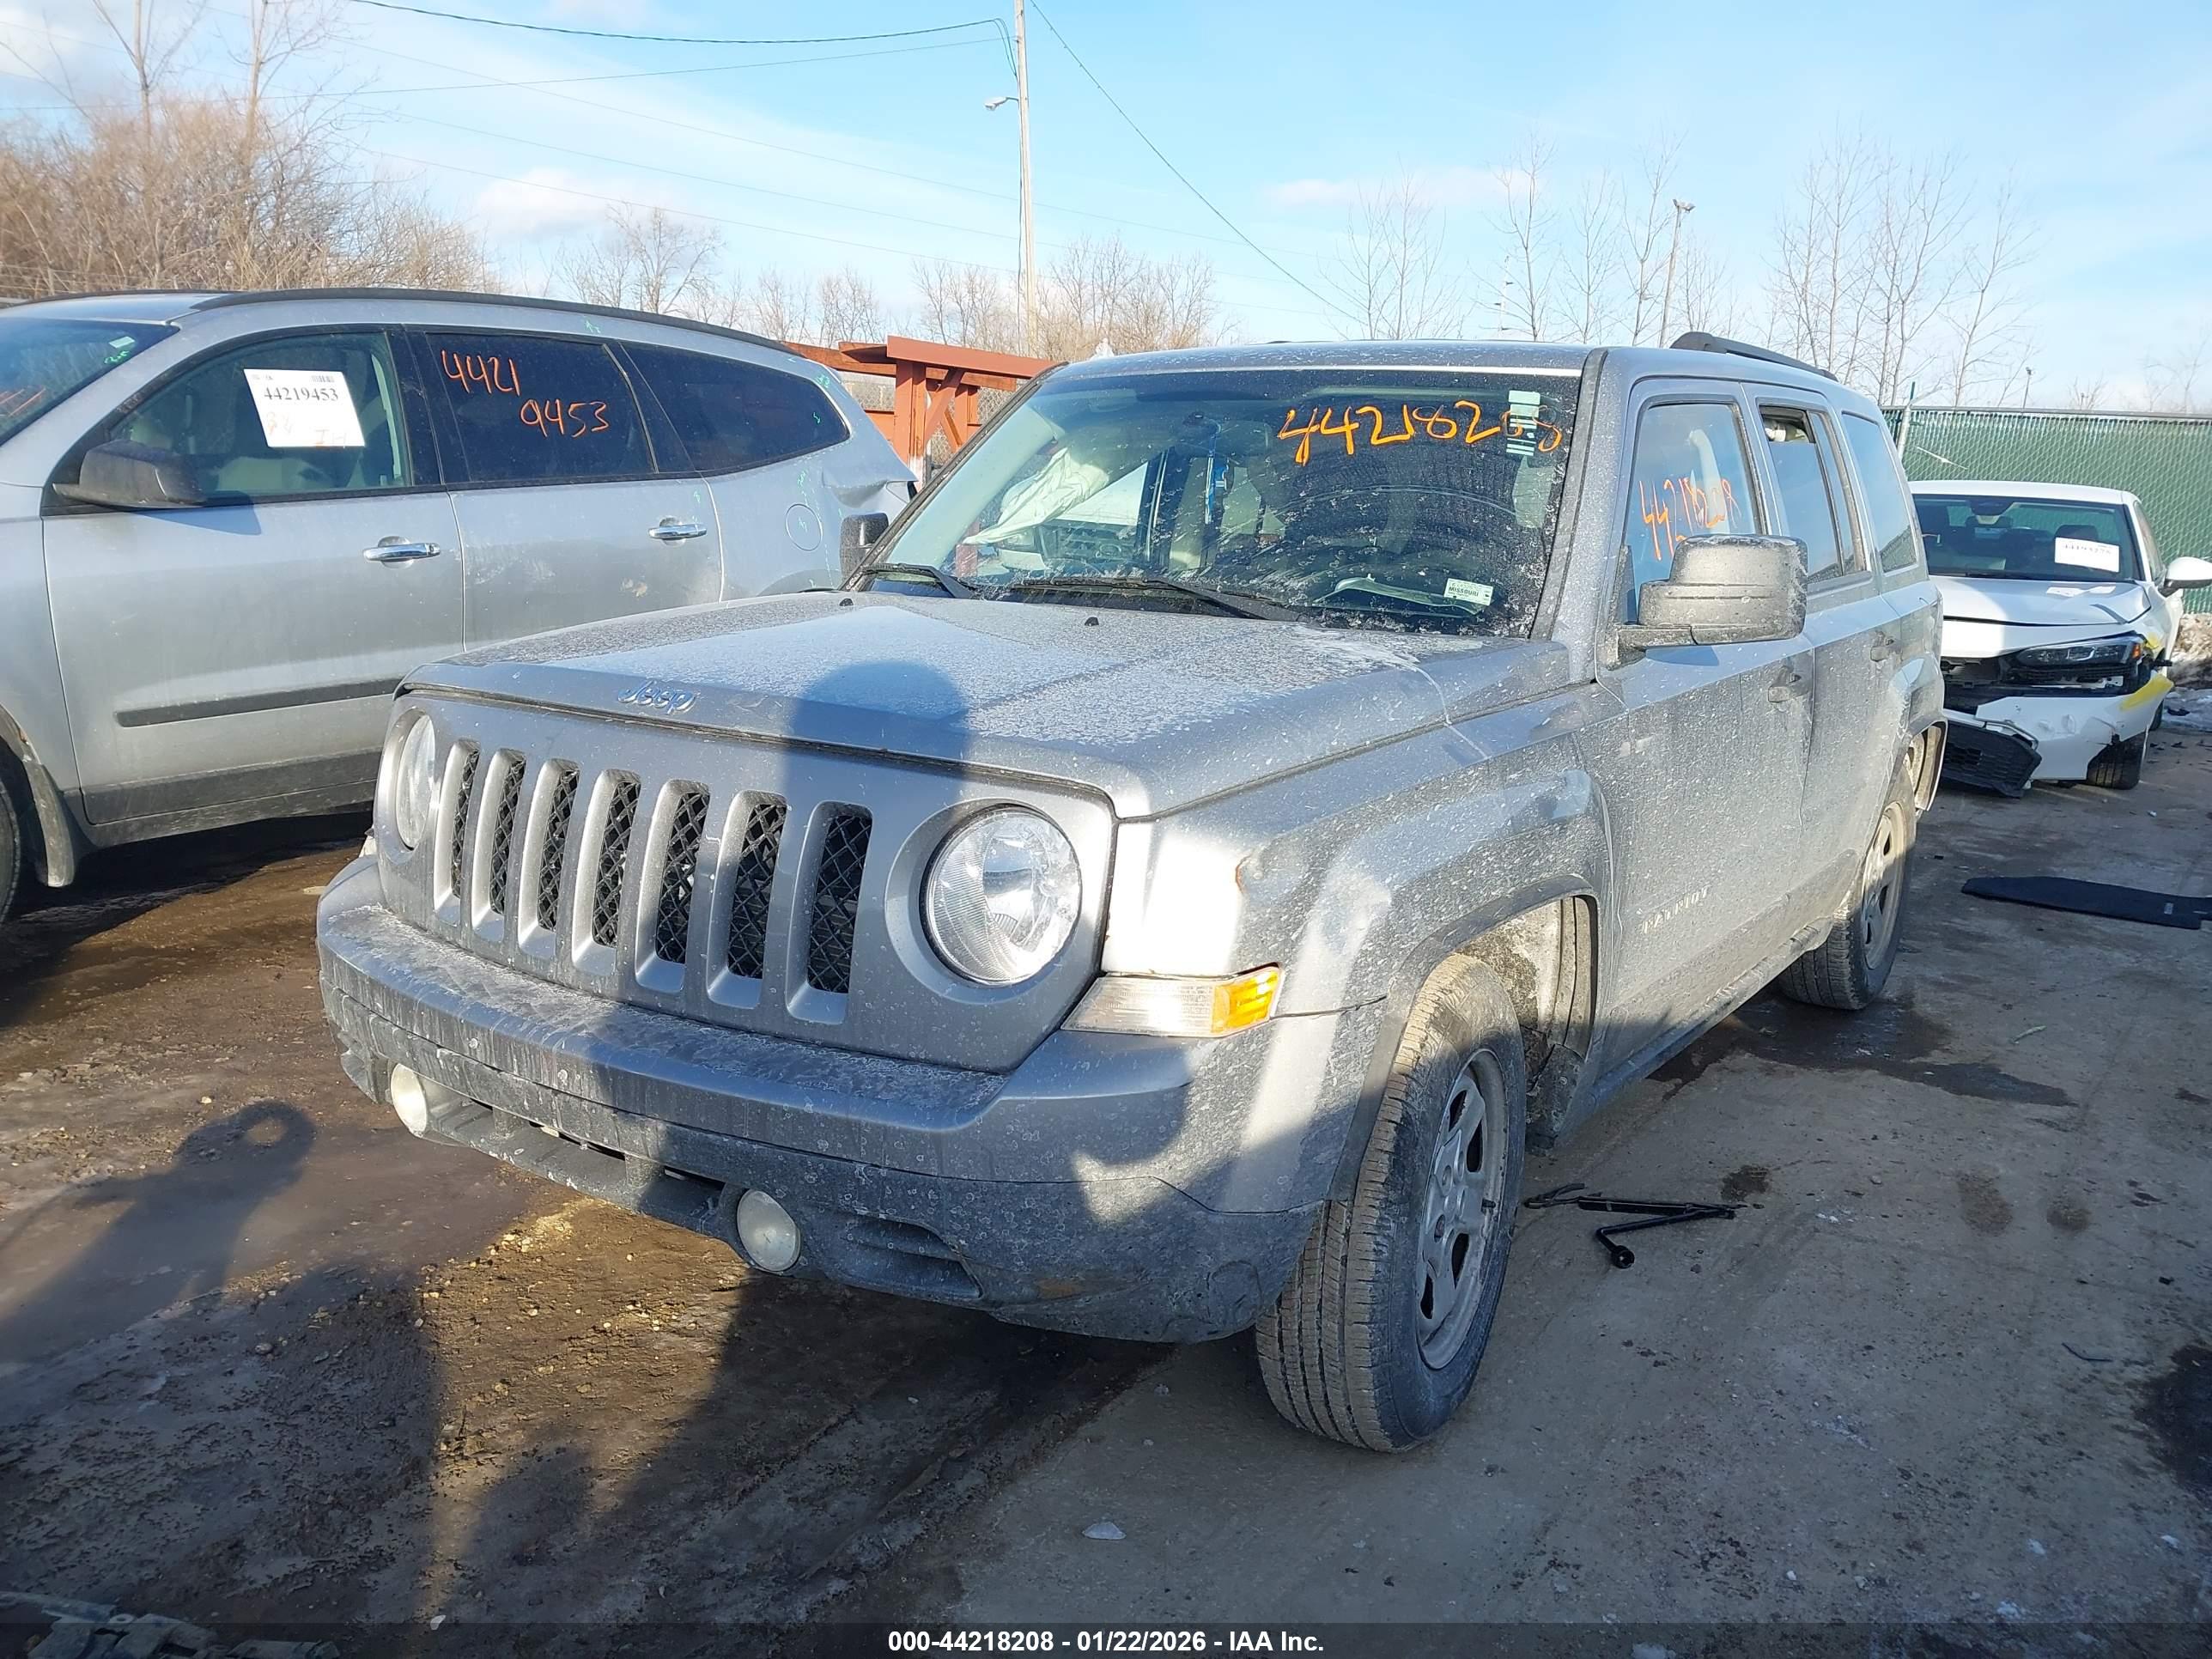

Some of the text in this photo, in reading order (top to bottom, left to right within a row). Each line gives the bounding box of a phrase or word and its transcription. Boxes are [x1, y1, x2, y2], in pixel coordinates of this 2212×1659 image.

[441, 349, 522, 397] 4421
[264, 386, 339, 402] 44219453
[520, 398, 611, 438] 9453
[1278, 399, 1563, 466] 44218208
[617, 680, 696, 715] Jeep
